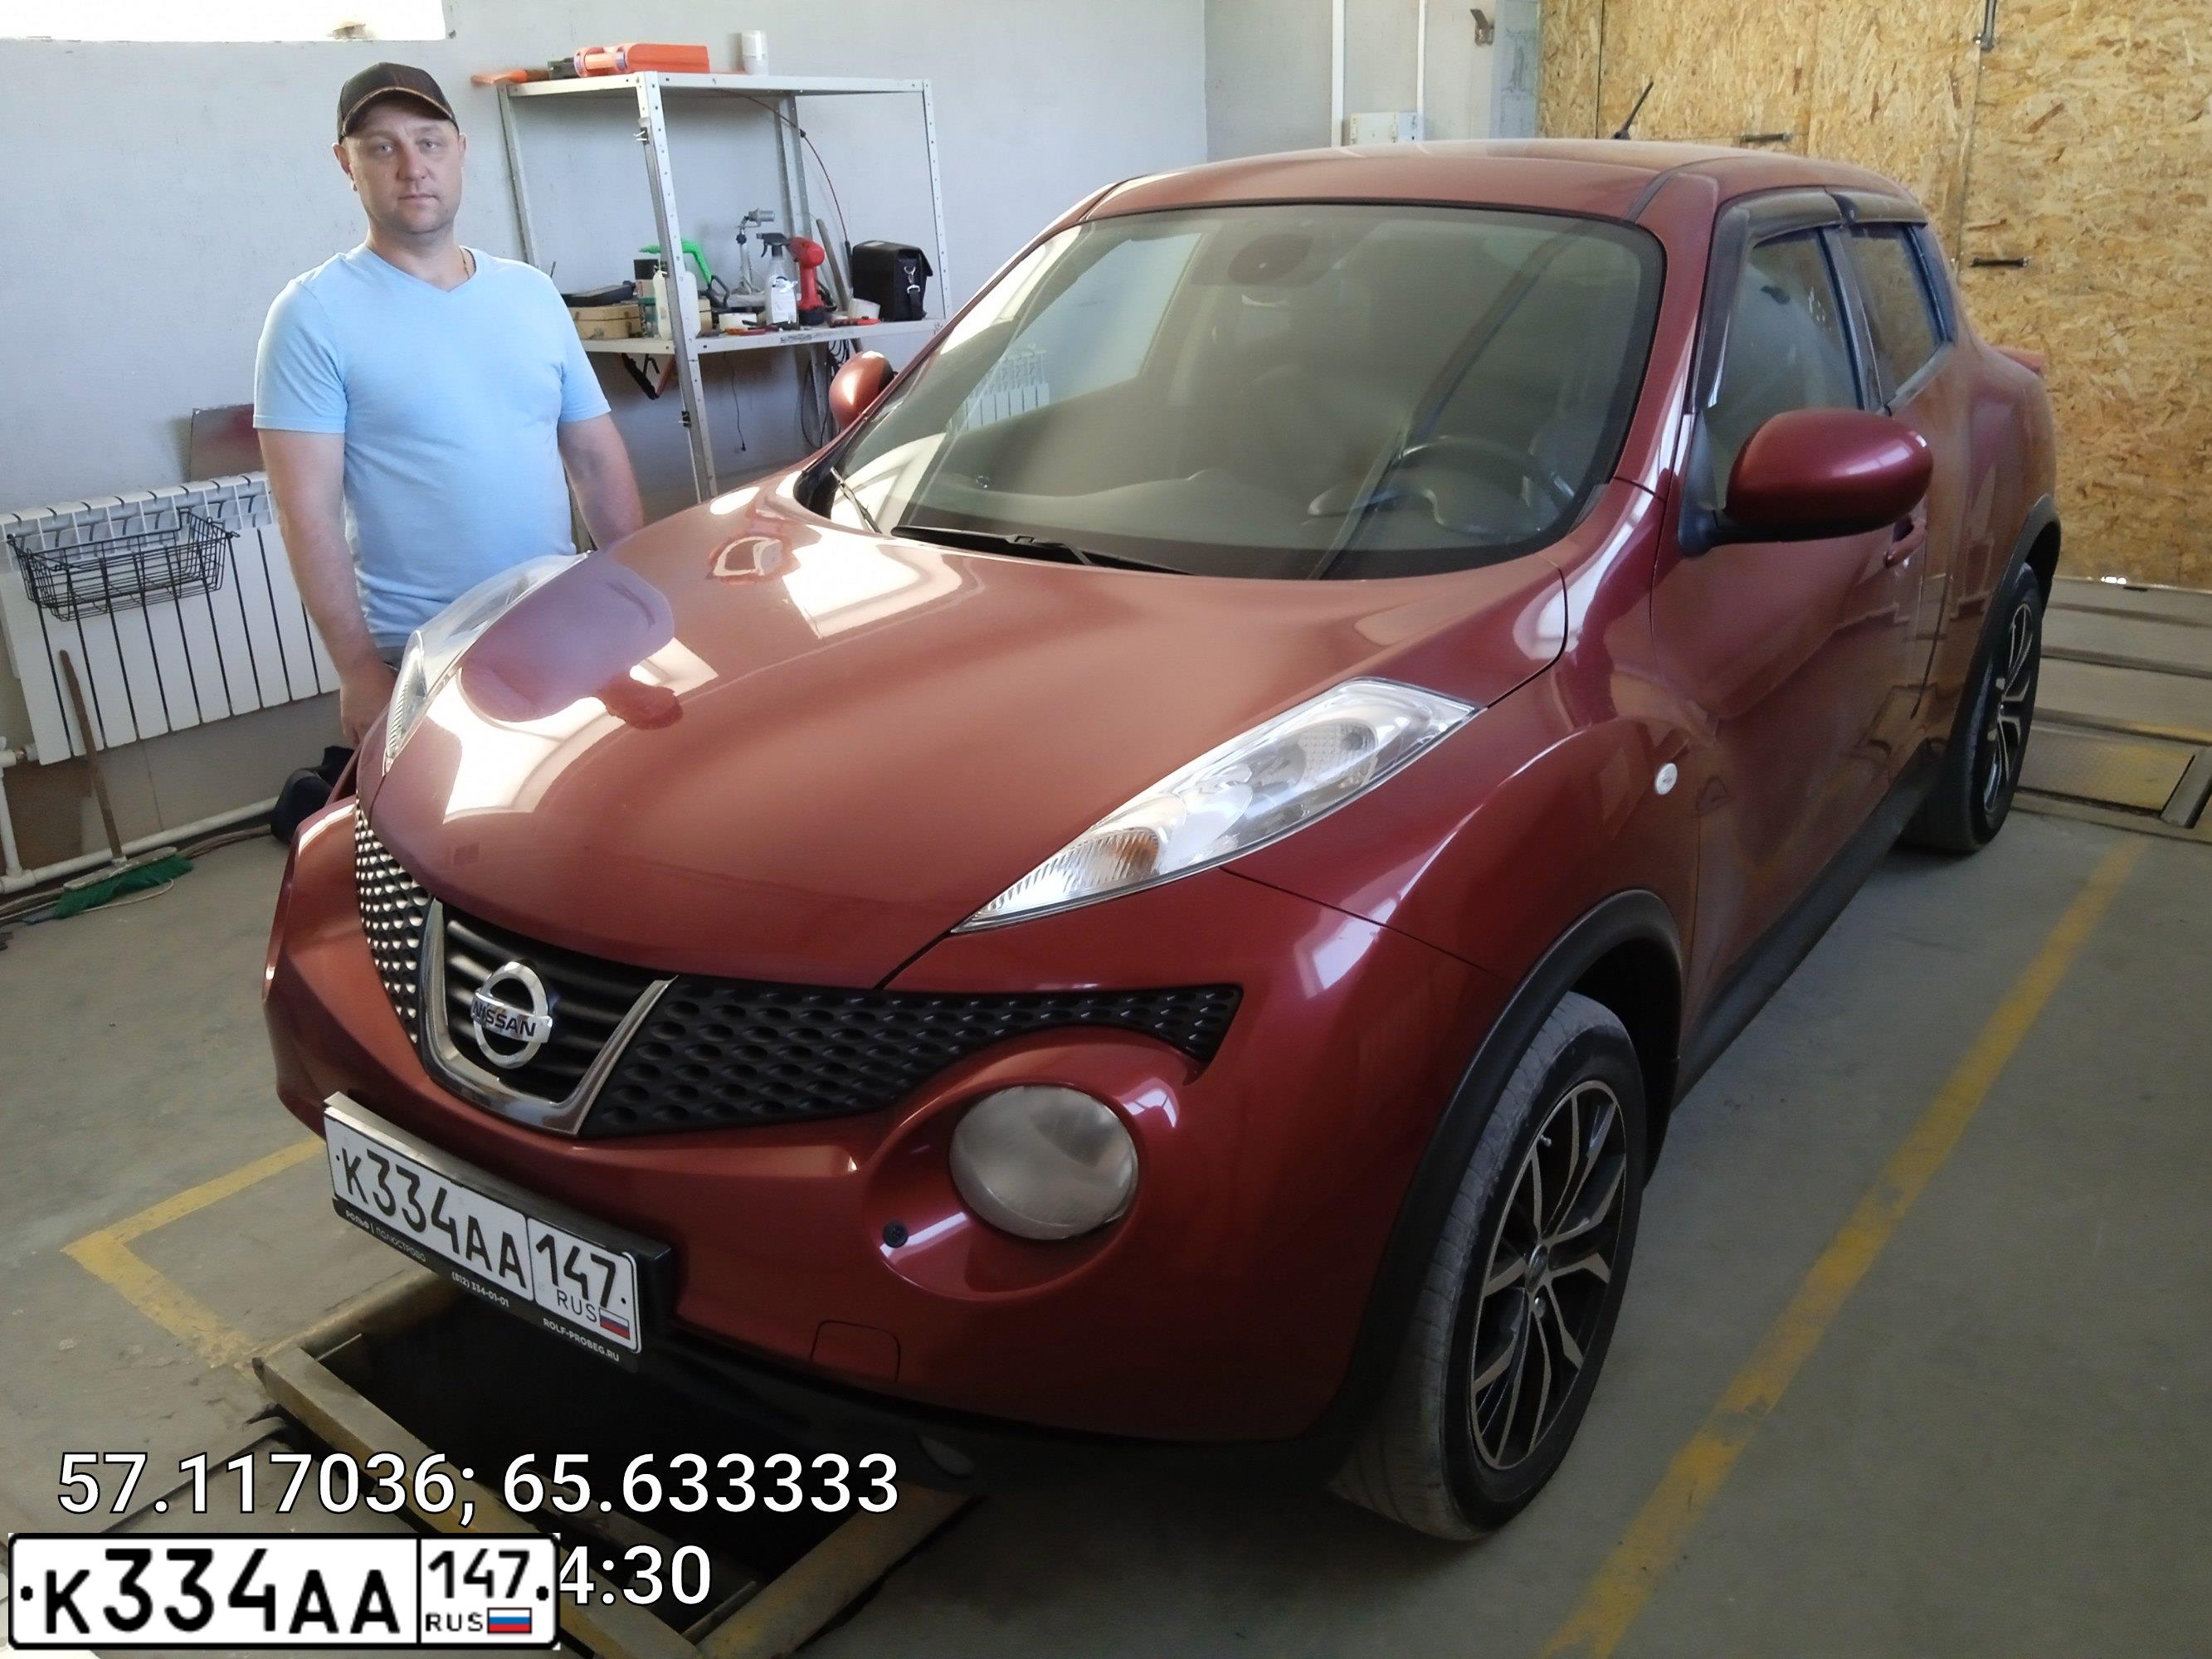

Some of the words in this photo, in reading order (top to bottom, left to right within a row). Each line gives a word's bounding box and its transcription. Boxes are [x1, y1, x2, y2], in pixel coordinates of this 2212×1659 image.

[472, 1000, 536, 1037] NISSAN
[536, 1233, 616, 1308] 147
[557, 1288, 597, 1323] RUS
[543, 1317, 620, 1362] ROLF-PROBEG.RU
